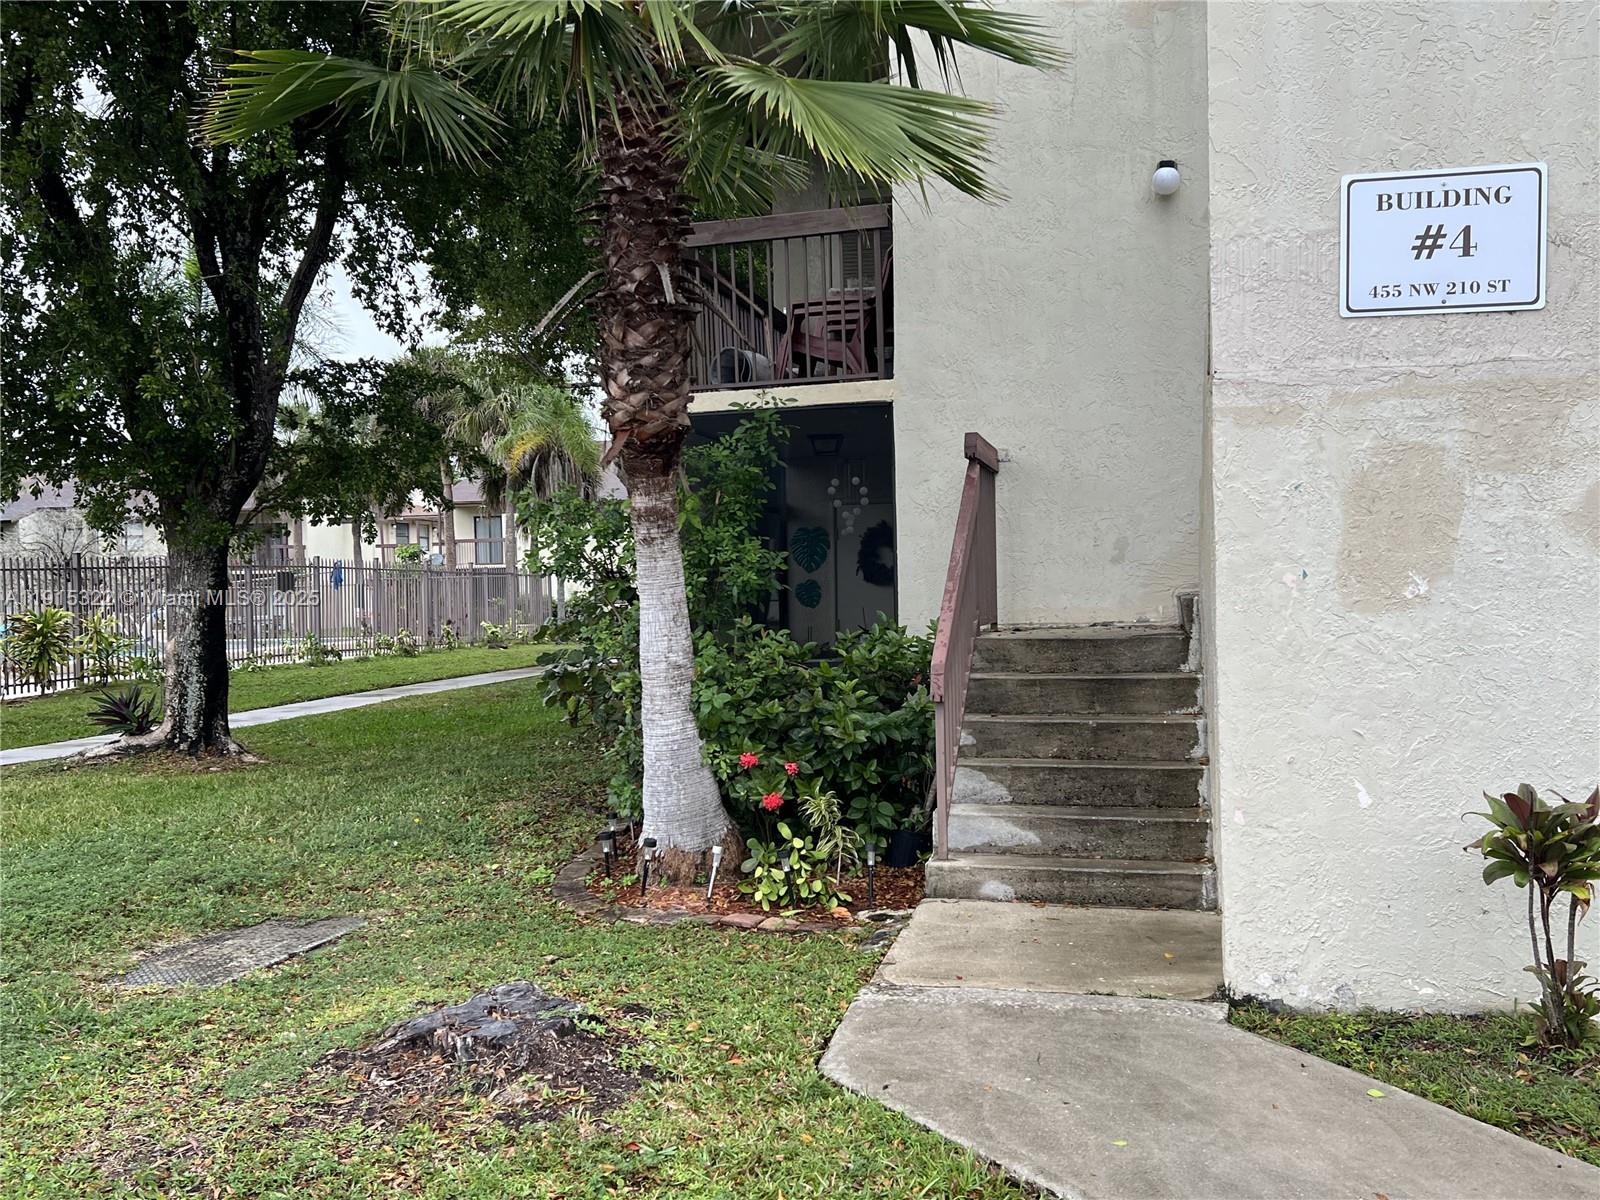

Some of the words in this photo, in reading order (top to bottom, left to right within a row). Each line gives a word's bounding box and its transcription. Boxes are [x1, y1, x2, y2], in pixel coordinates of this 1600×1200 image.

[1376, 185, 1512, 212] BUILDING
[1411, 224, 1477, 260] #4
[1368, 284, 1402, 299] 455
[1409, 283, 1440, 297] NW
[1446, 280, 1481, 295] 210
[1487, 279, 1511, 293] ST
